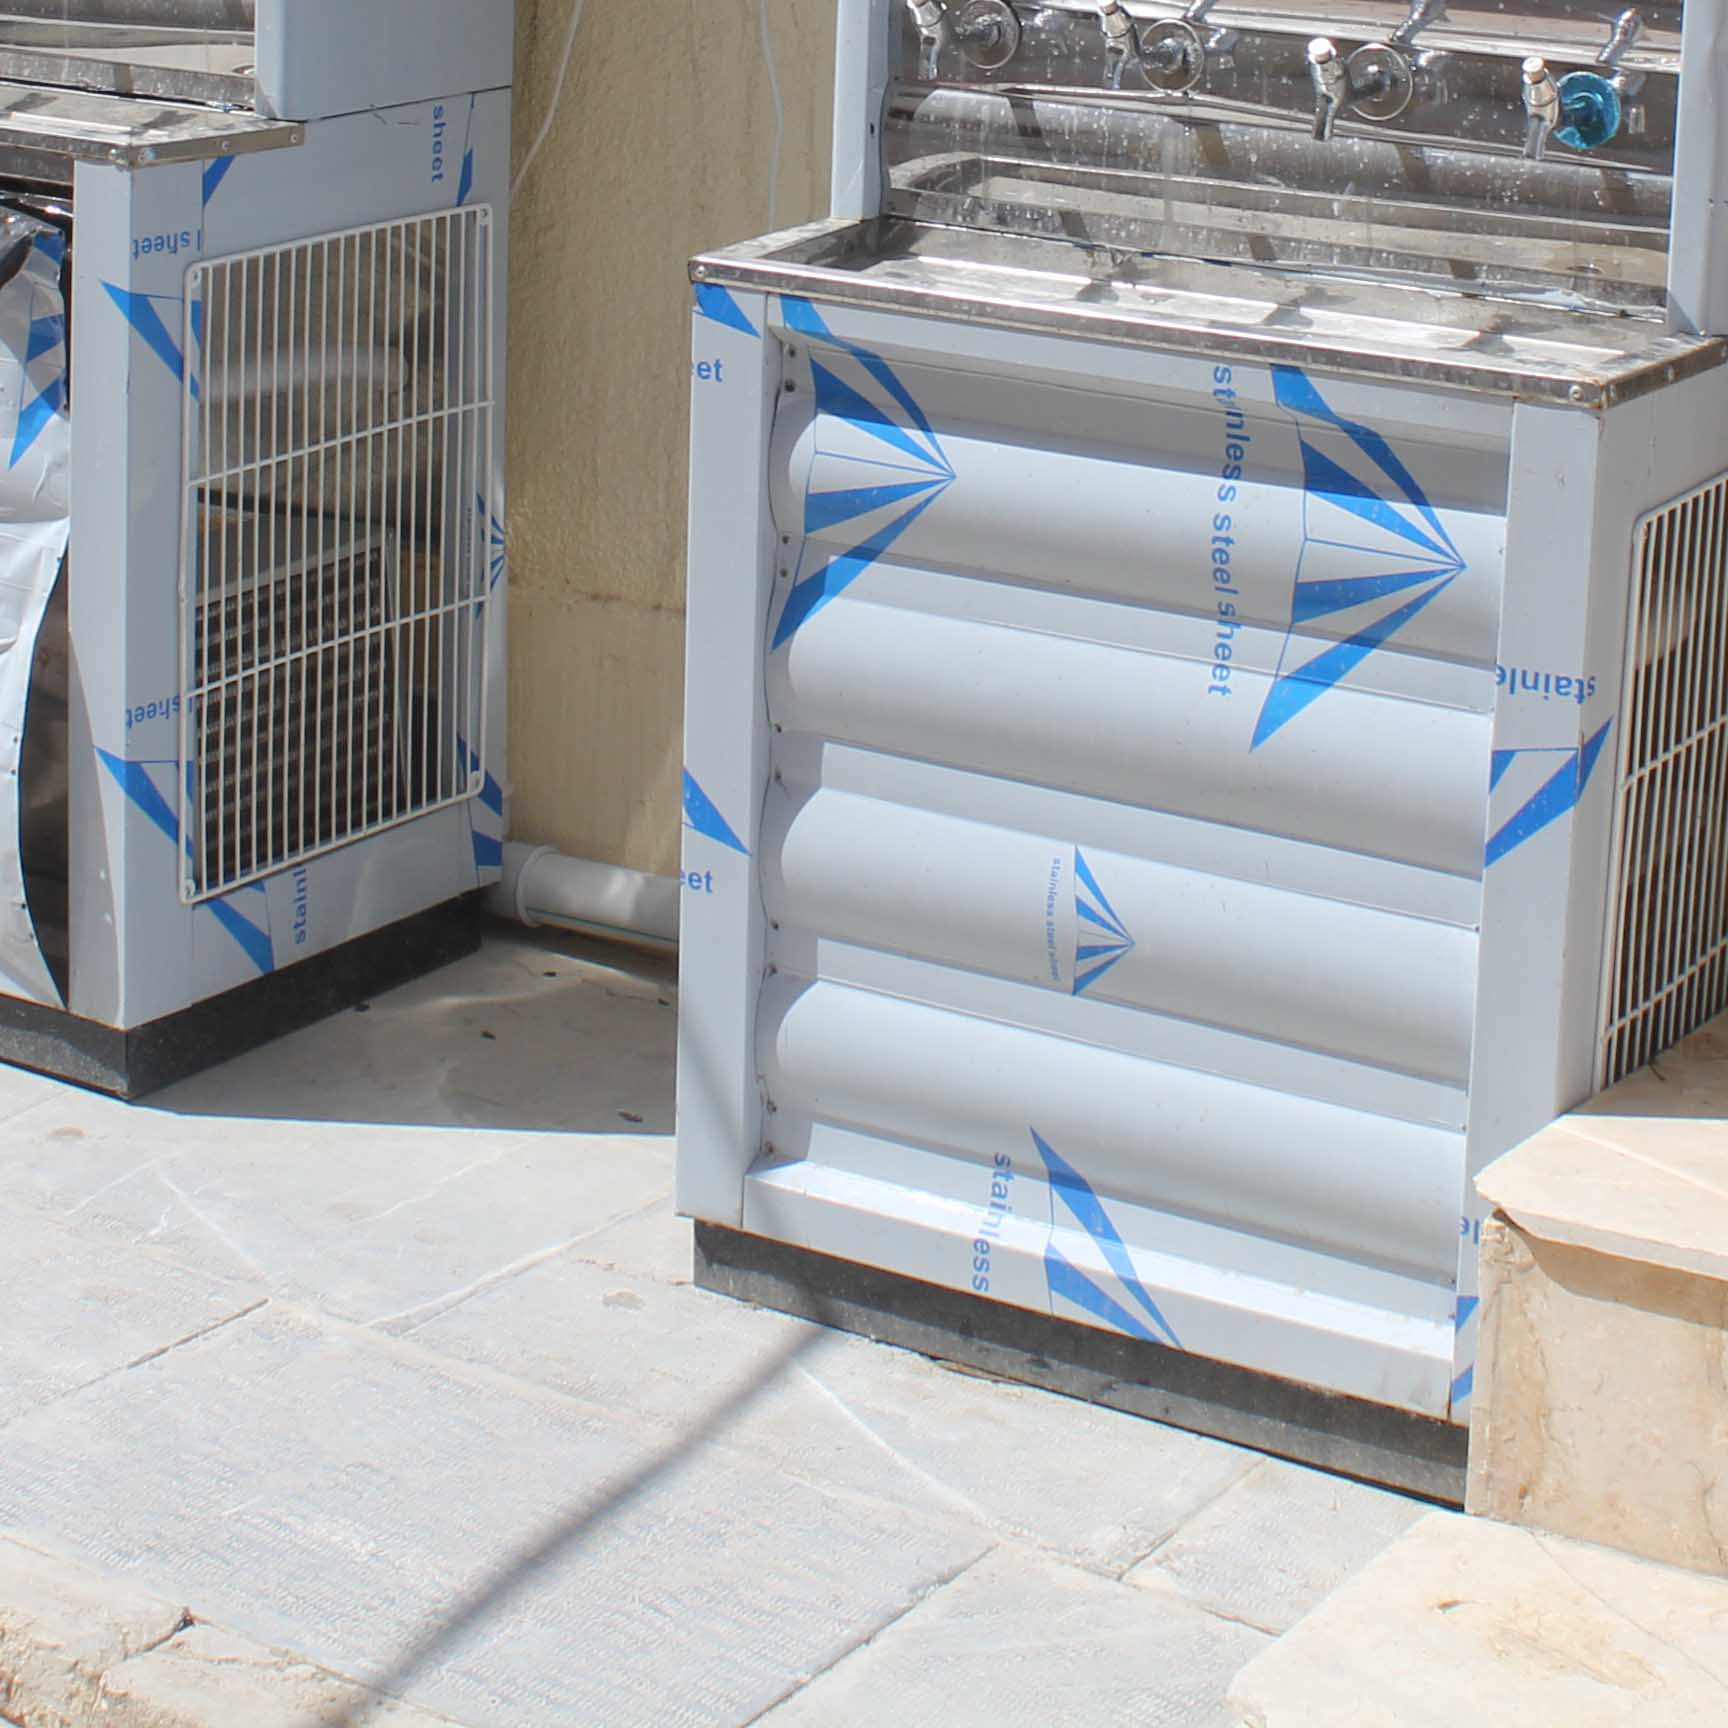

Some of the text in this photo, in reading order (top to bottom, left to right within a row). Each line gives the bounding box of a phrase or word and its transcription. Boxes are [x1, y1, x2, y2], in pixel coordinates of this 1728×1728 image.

[431, 105, 447, 184] sheet
[131, 230, 191, 260] sheet
[689, 358, 724, 384] et
[1211, 513, 1240, 595] steel
[1207, 600, 1245, 697] sheet
[971, 1151, 1015, 1293] stainless
